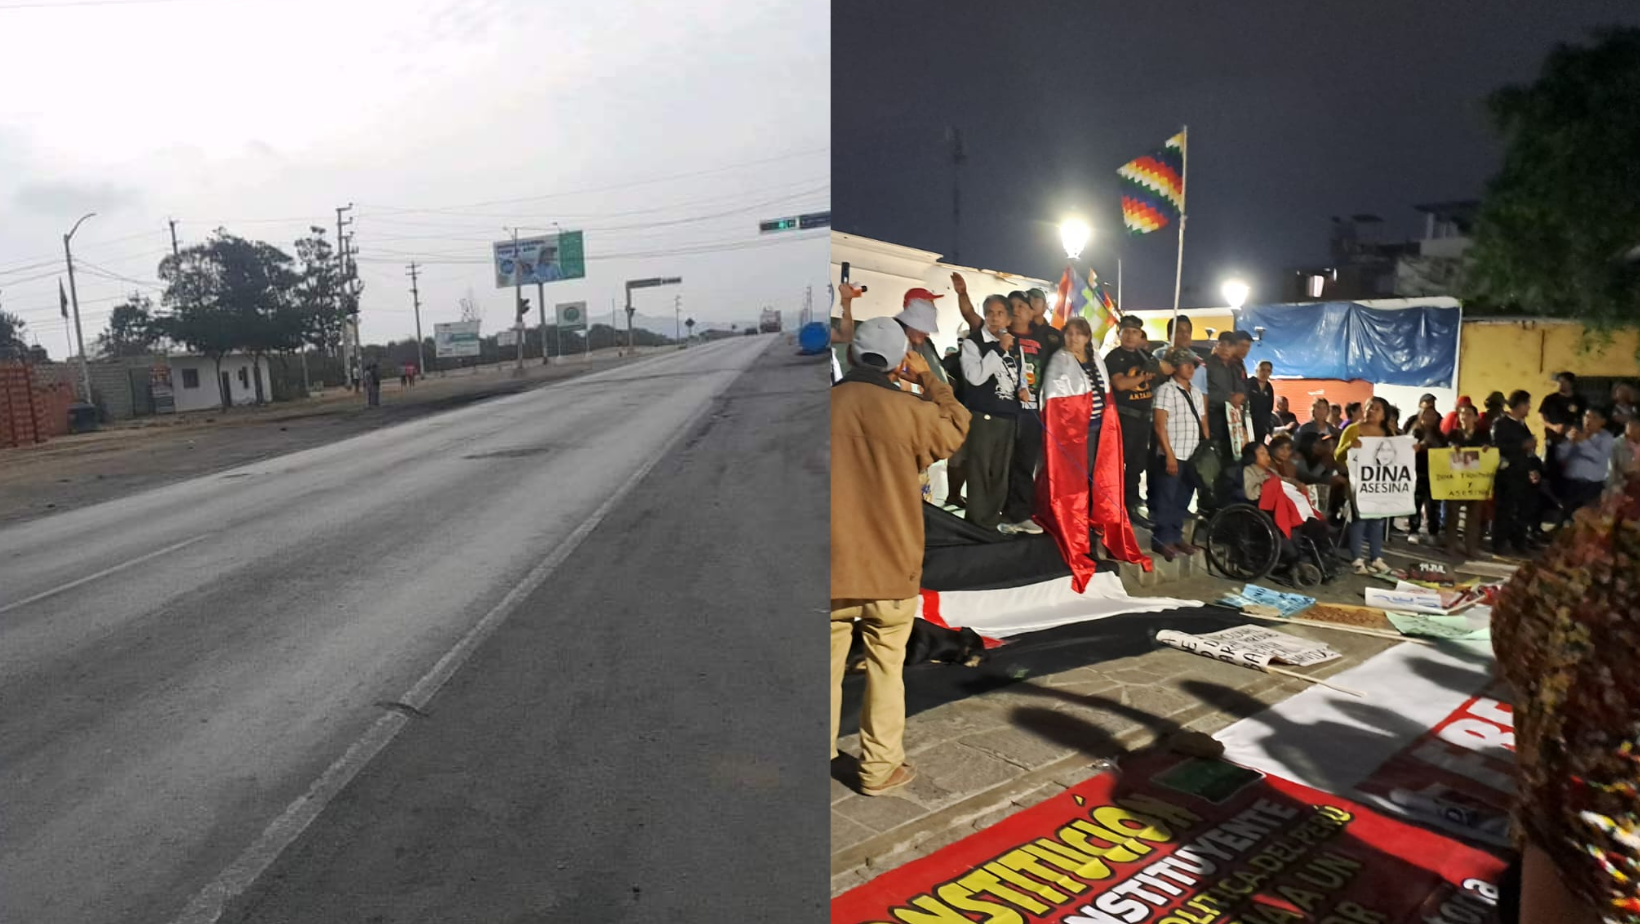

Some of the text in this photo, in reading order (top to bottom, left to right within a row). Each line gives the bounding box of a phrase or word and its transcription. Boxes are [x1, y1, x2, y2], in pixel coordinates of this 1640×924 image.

[1361, 465, 1411, 482] DINA
[1359, 482, 1409, 493] ASESINA
[860, 793, 1205, 924] NSTITUCIÓN
[1295, 851, 1362, 889] UN
